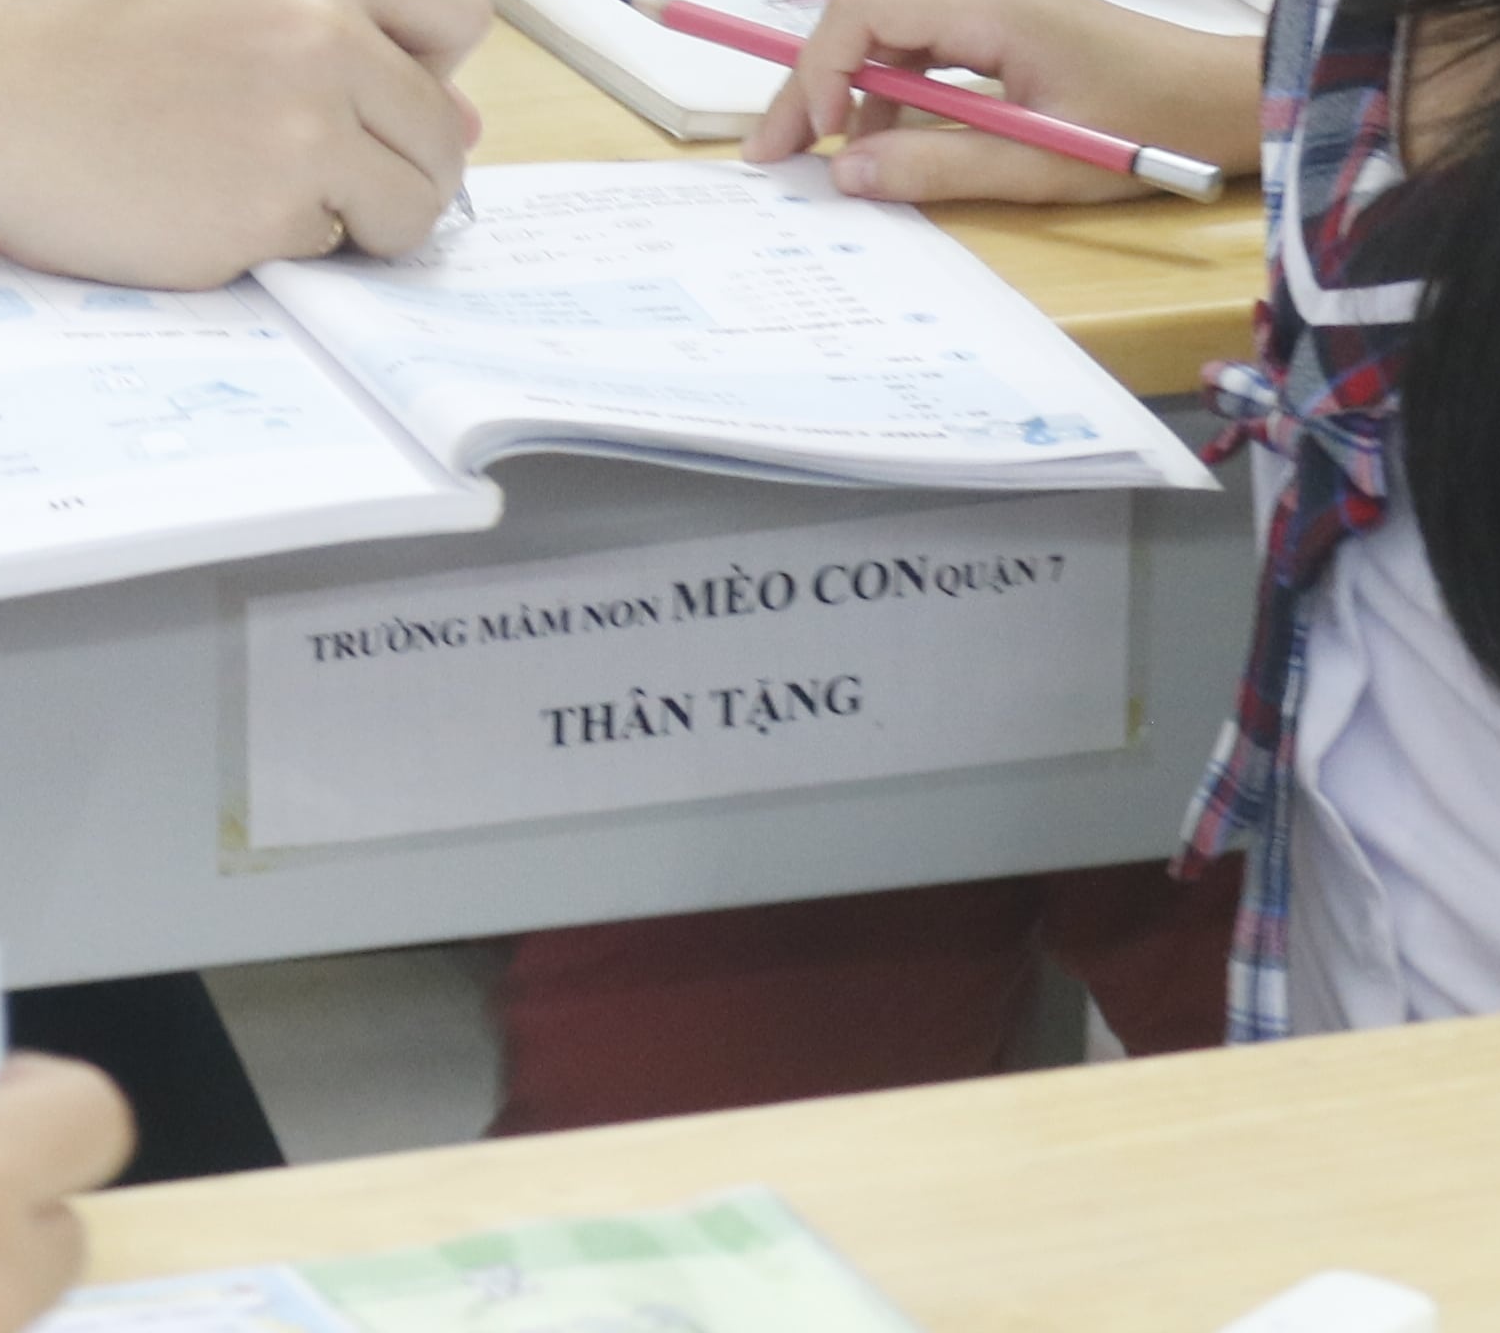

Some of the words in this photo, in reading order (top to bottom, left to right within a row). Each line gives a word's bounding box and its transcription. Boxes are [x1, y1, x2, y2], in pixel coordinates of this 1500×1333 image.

[306, 614, 469, 662] TRƯỜNG
[476, 602, 574, 644] MẦM
[581, 596, 660, 633] NON
[670, 562, 798, 622] MÈO
[812, 554, 929, 606] CON
[1047, 554, 1066, 583] 7
[538, 685, 695, 748] THÂN
[708, 674, 864, 735] TẶNG
